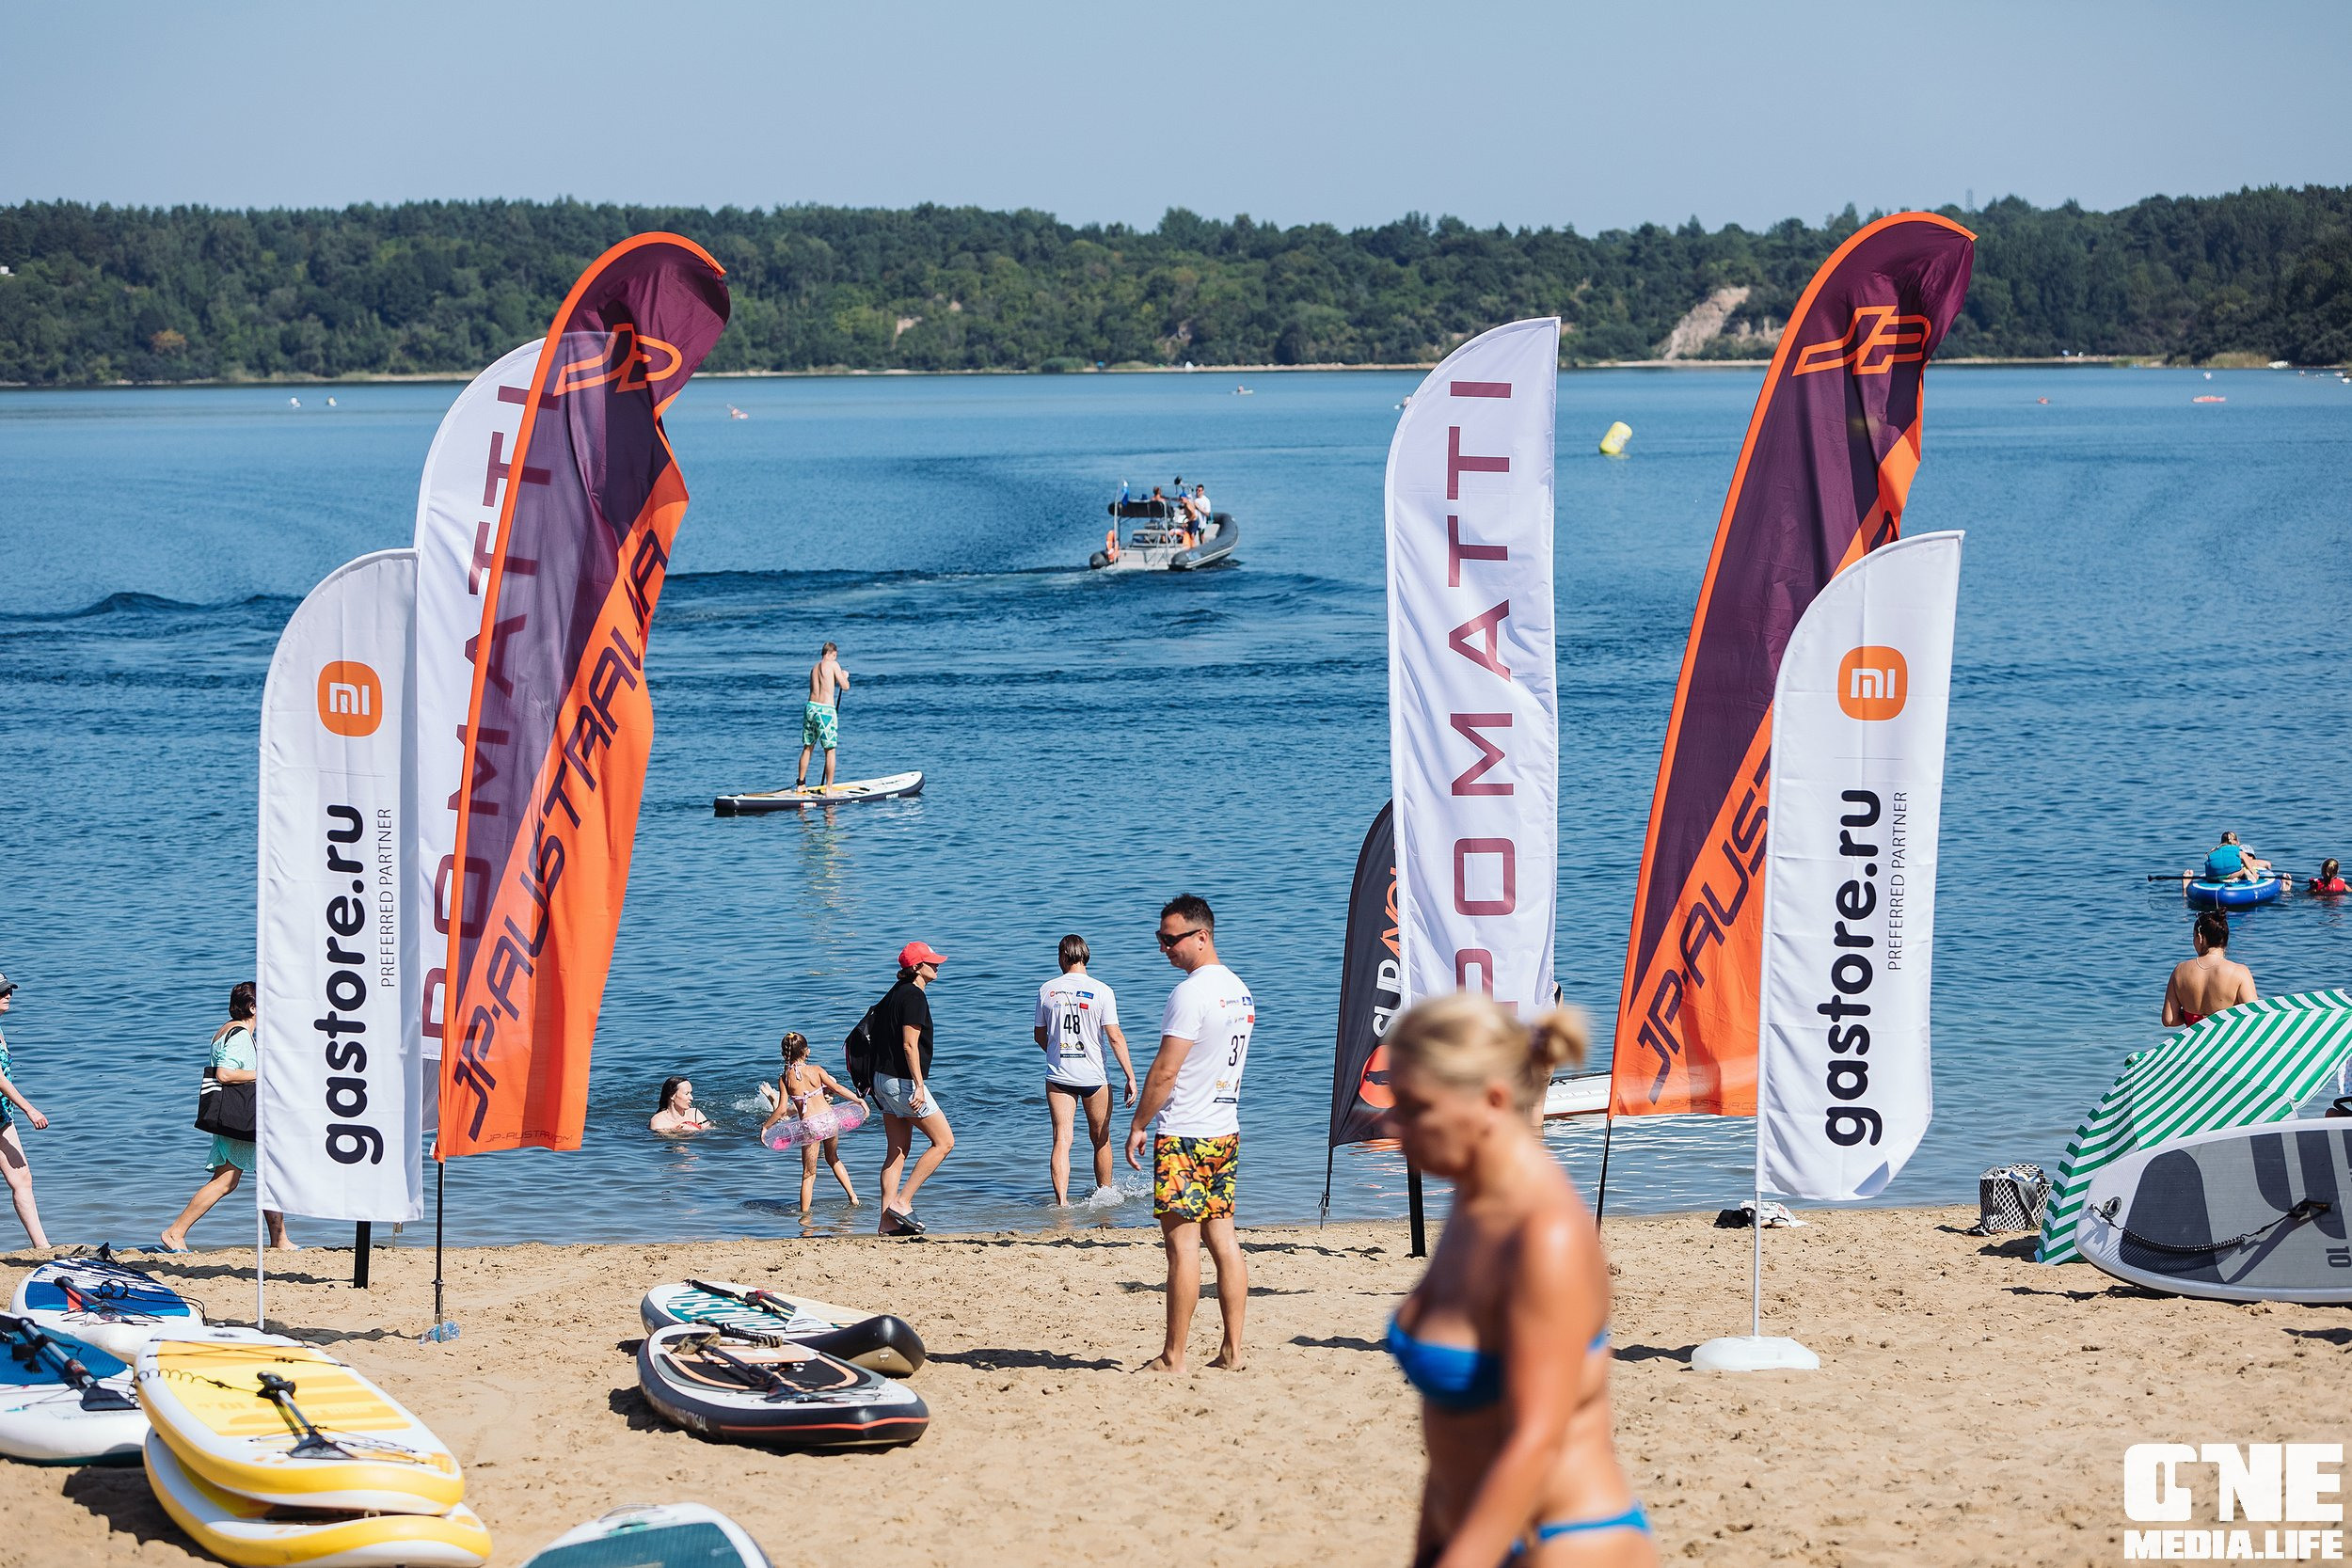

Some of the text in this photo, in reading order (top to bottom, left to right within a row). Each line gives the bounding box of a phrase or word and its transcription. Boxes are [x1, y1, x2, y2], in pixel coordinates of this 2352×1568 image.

[1446, 380, 1519, 1019] POMATTI
[376, 808, 395, 988] PREFERRED PARTNER
[1817, 788, 1883, 1148] gastore.ru
[1887, 792, 1907, 972] PREFERRED PARTNER
[313, 803, 384, 1165] gastore.ru
[1063, 1013, 1081, 1036] 48
[1228, 1035, 1246, 1067] 37
[2325, 1245, 2352, 1268] 10
